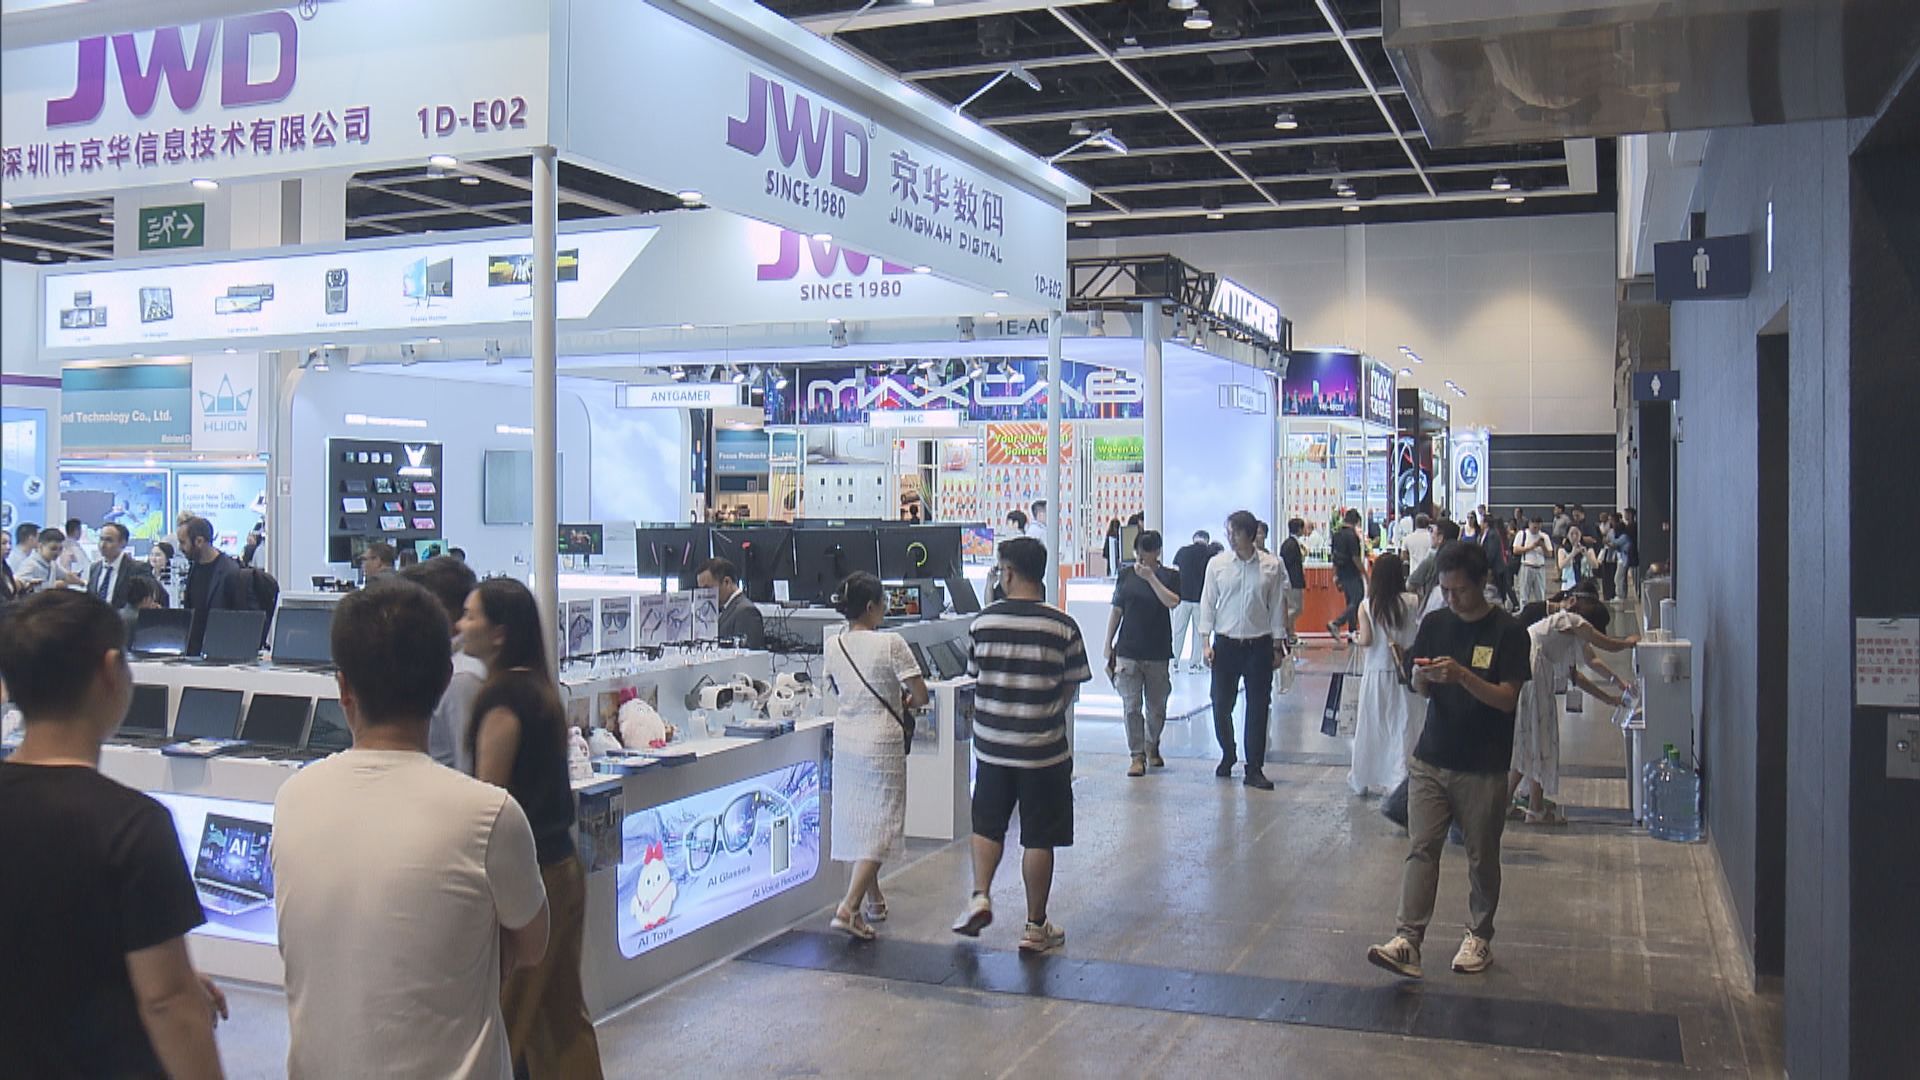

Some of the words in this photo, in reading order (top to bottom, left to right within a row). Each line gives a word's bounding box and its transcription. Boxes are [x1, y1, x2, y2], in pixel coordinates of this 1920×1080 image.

[46, 10, 297, 127] JWD
[417, 96, 527, 138] 1D-E02
[1, 106, 372, 178] 深圳市京华信息技术有限公司
[727, 72, 868, 196] JWD
[766, 170, 810, 207] SINCE
[813, 187, 846, 219] 1980
[890, 150, 1003, 237] 京华数码
[890, 206, 952, 244] JINGWAH
[959, 232, 1003, 263] DIGITAL
[800, 282, 853, 301] SINCE
[859, 280, 902, 297] 1980
[651, 390, 711, 401] ANTGAMER
[76, 411, 130, 424] Technology
[153, 410, 173, 421] Ltd.
[203, 420, 248, 432] HUION
[904, 414, 924, 424] HKC
[229, 838, 247, 857] AI
[708, 875, 717, 888] AI
[638, 935, 649, 949] AI
